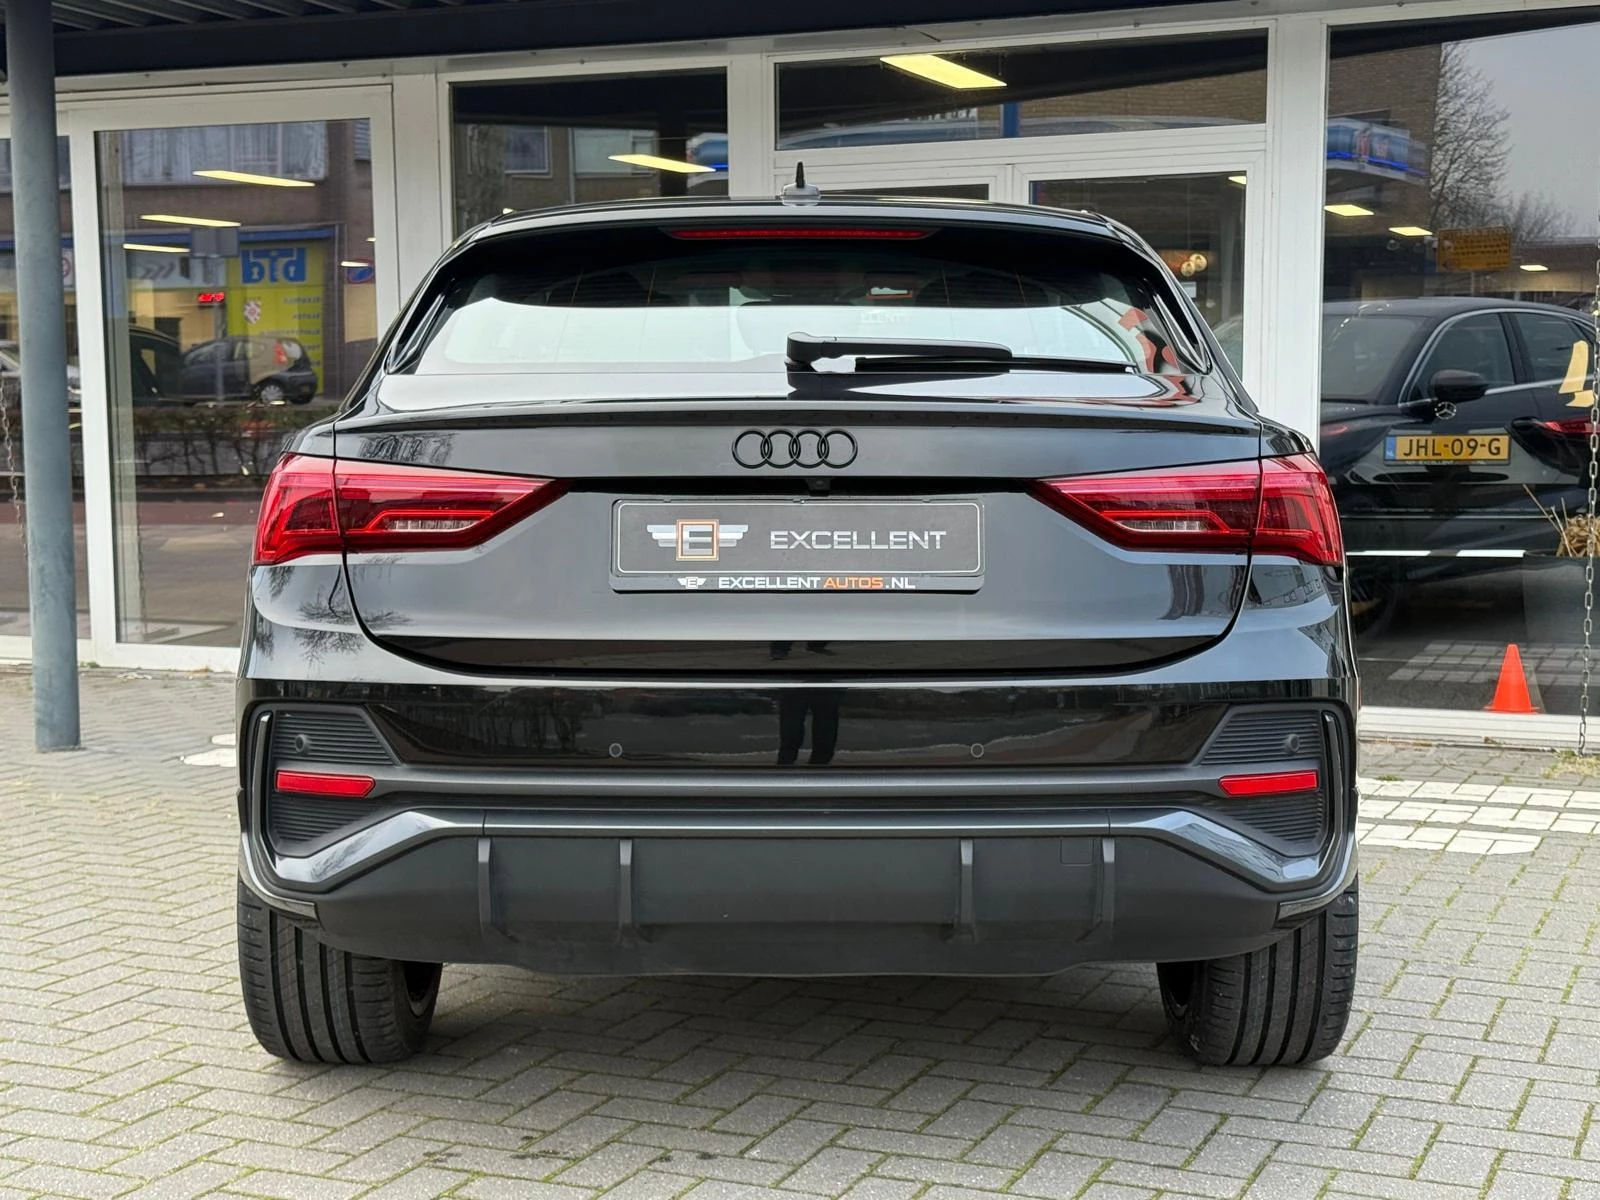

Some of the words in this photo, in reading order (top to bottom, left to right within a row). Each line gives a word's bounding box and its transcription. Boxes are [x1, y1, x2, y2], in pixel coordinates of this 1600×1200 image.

[1403, 438, 1501, 457] JHL-09-G
[683, 525, 712, 555] E
[770, 531, 947, 549] EXCELLENT
